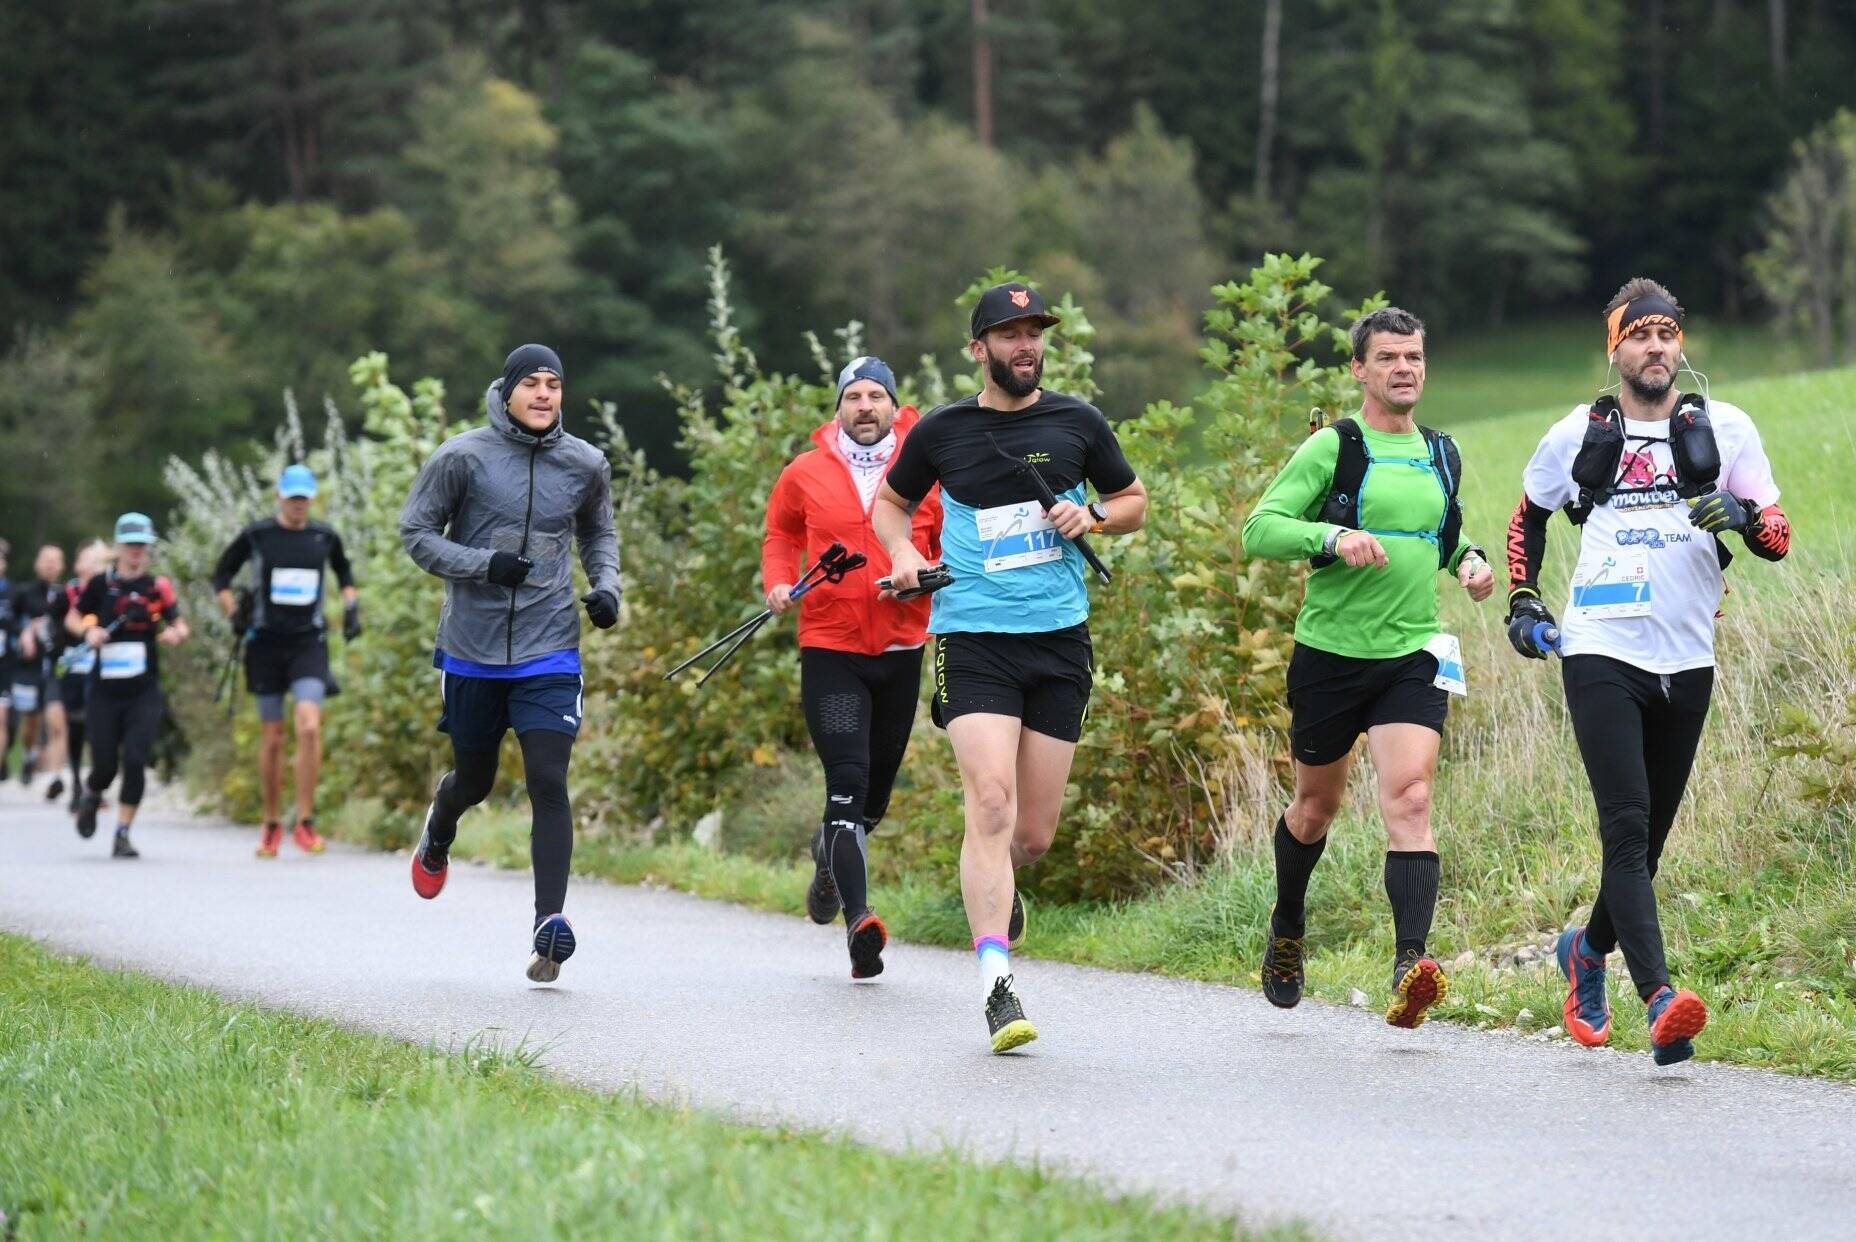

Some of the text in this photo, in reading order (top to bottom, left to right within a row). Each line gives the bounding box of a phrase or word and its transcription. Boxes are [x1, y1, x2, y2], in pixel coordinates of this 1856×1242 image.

[1023, 528, 1057, 552] 117
[1664, 533, 1692, 543] TEAM
[1631, 582, 1646, 602] 7
